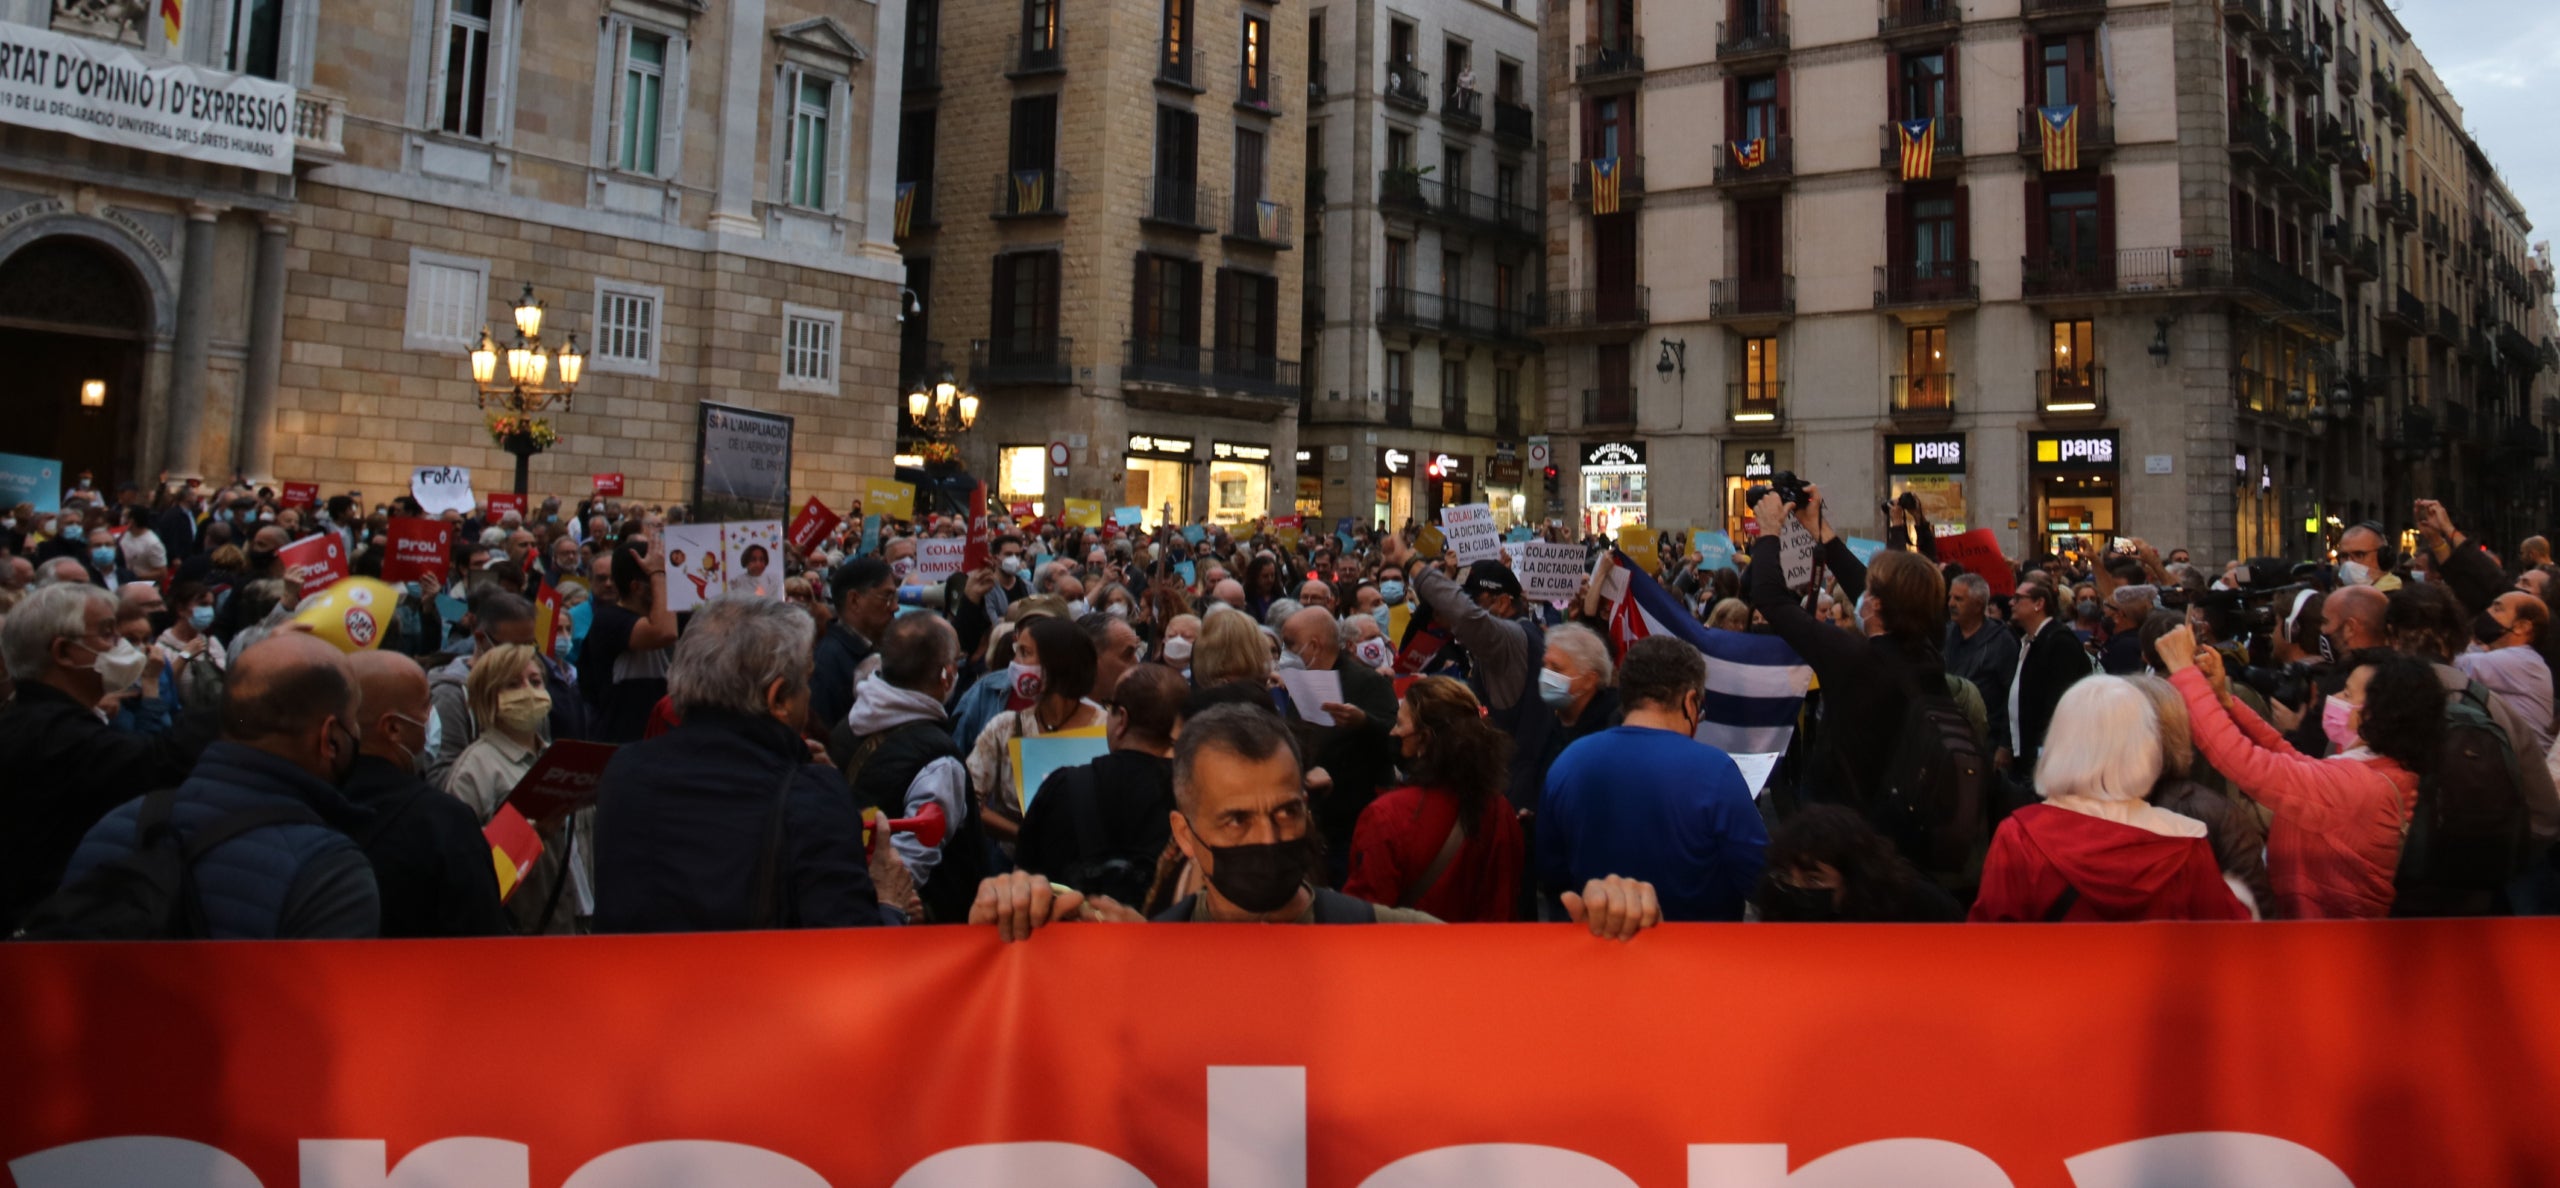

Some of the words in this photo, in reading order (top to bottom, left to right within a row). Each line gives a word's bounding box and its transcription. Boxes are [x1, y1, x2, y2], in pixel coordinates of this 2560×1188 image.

[171, 80, 287, 134] D'EXPRESSIÓ
[15, 94, 30, 111] DE
[33, 97, 46, 113] LA
[117, 115, 173, 140] UNIVERSAL
[175, 126, 199, 145] DELS
[201, 131, 229, 151] DRETS
[231, 137, 274, 157] HUMANS
[730, 418, 787, 440] L'AMPLIACIÓ
[728, 438, 739, 451] DE
[2061, 438, 2113, 461] pans
[1589, 442, 1638, 464] BARCELONA
[1915, 441, 1960, 464] pans
[1746, 464, 1771, 478] pans
[1448, 509, 1472, 523] COLAU
[1449, 527, 1459, 539] LA
[1459, 543, 1471, 553] EN
[1473, 540, 1496, 551] CUBA
[1526, 546, 1556, 559] COLAU
[1558, 548, 1584, 560] APOYA
[1523, 562, 1535, 573] LA
[1537, 562, 1583, 575] DICTADURA
[1530, 577, 1544, 588] EN
[1547, 577, 1573, 589] CUBA
